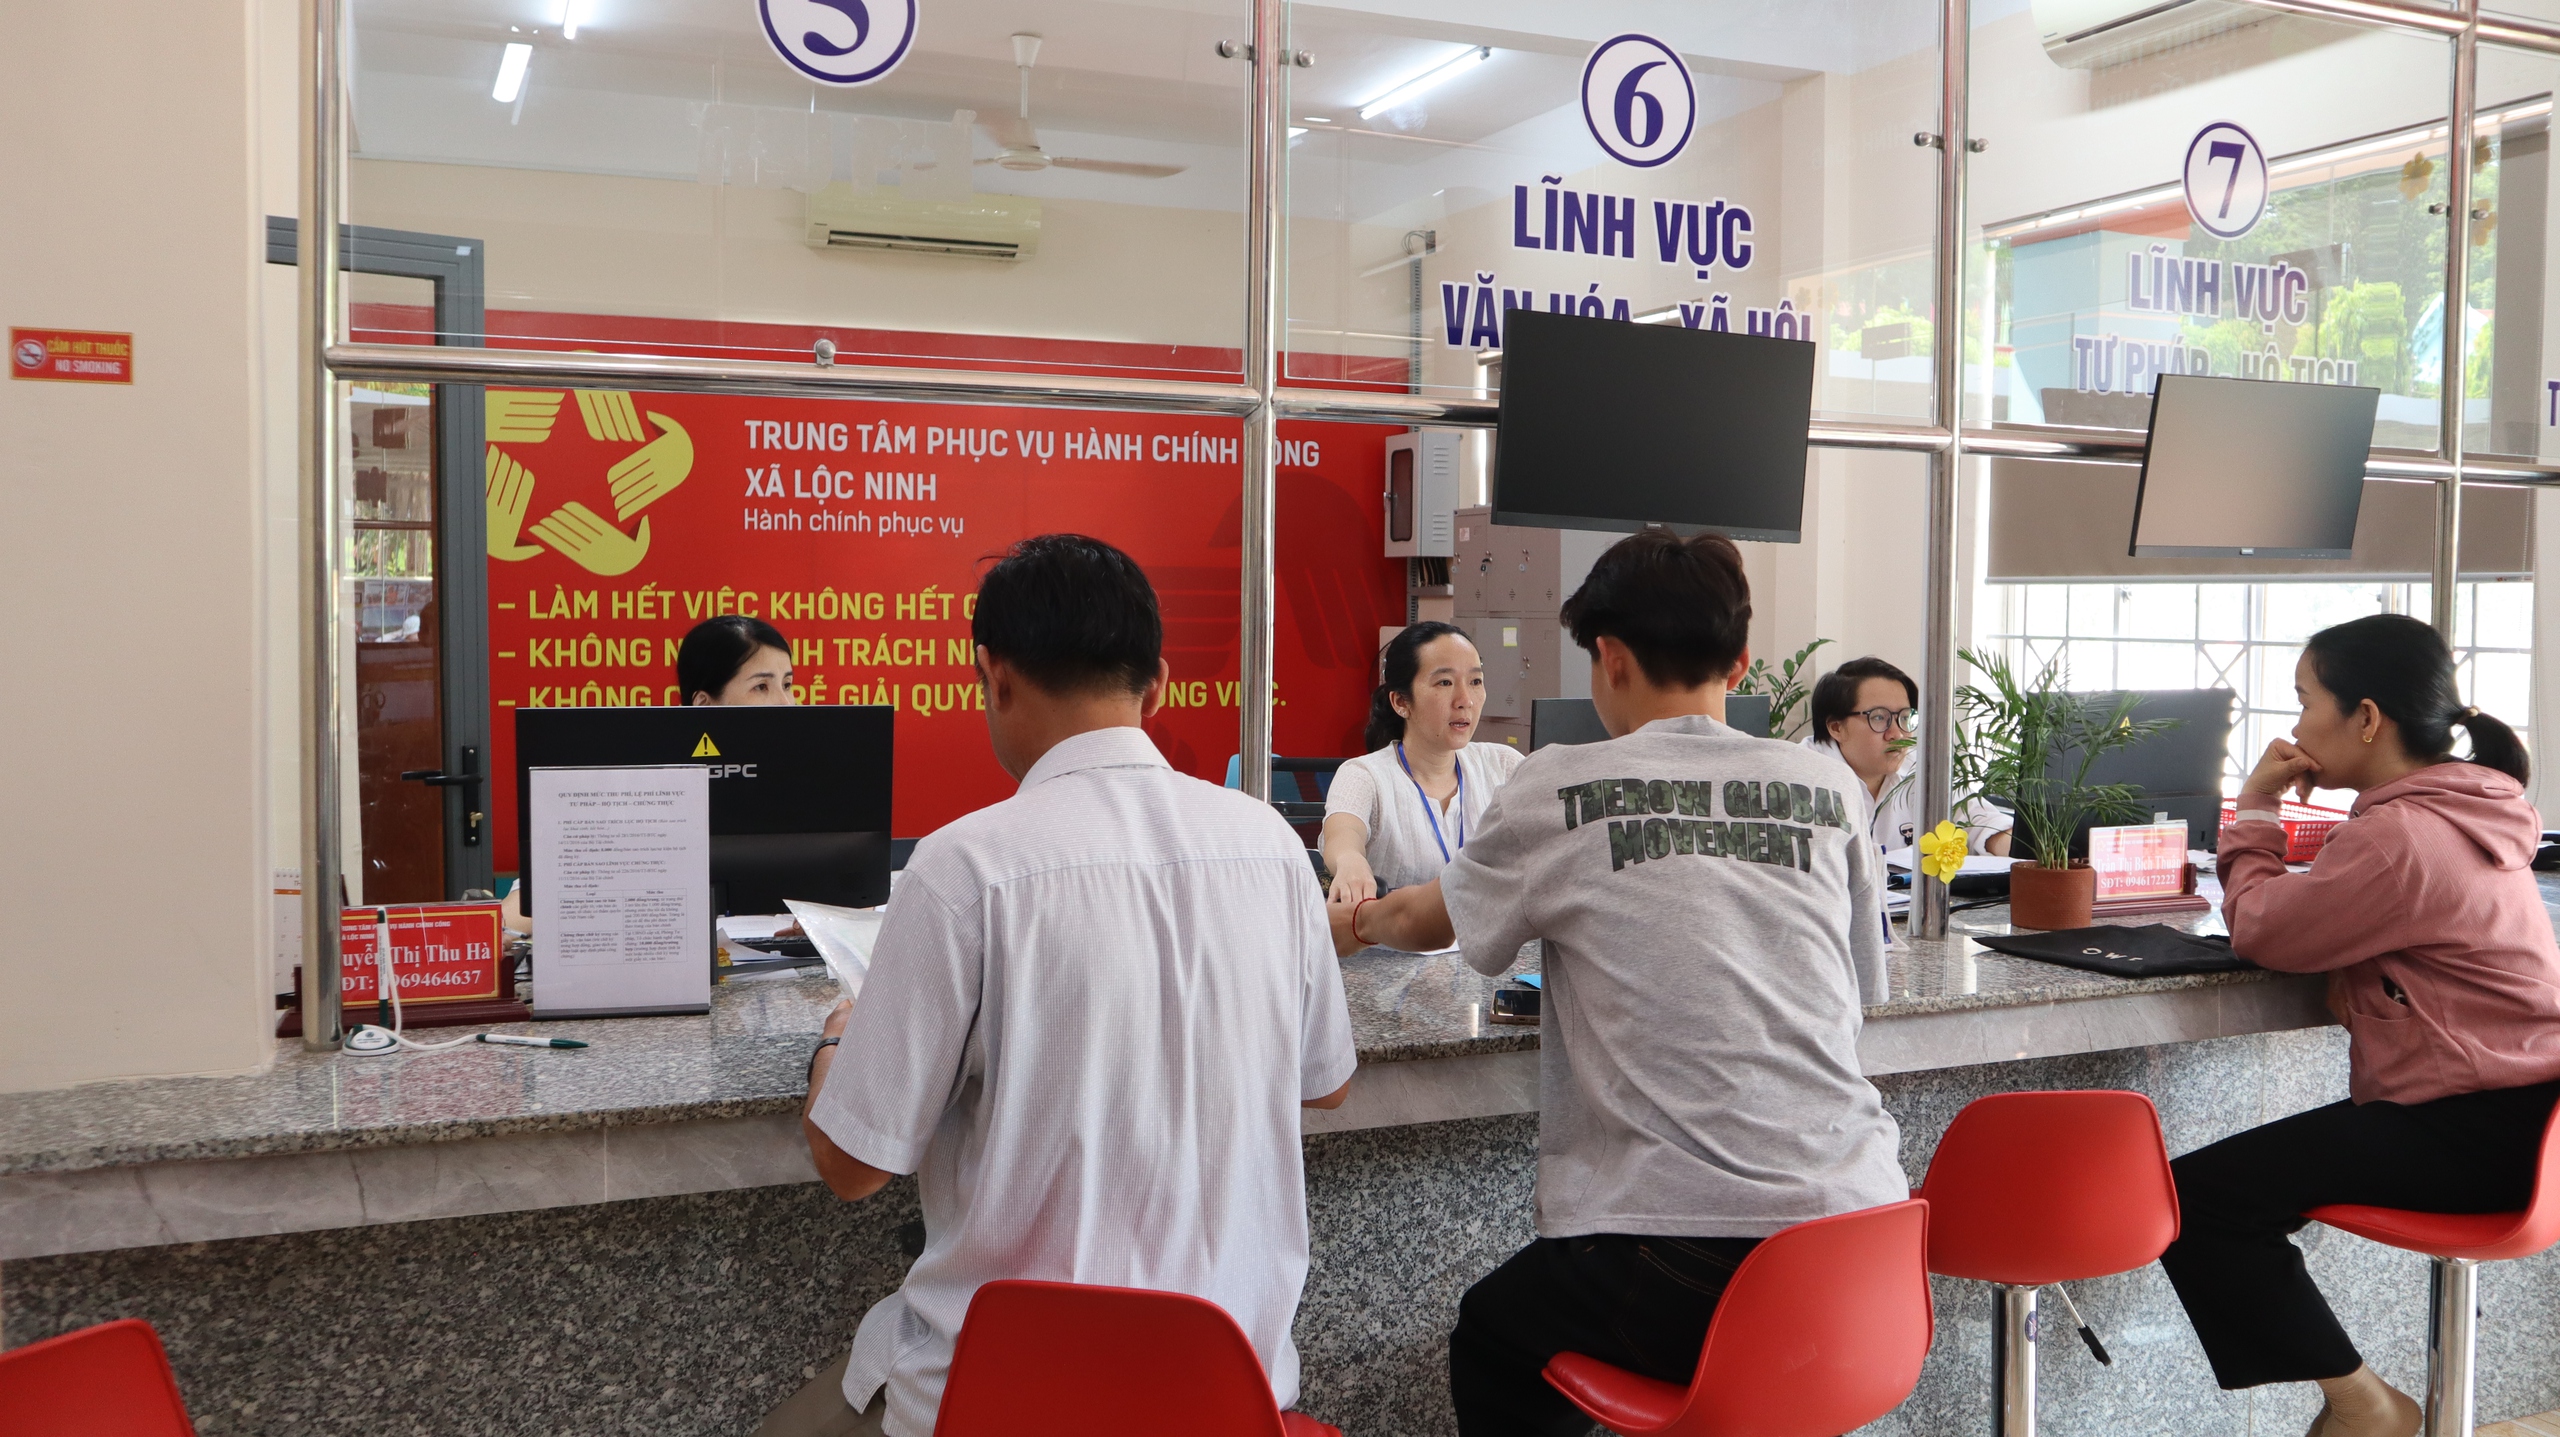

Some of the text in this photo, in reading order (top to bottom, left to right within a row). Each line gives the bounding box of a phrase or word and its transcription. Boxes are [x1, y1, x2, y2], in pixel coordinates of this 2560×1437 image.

[1614, 61, 1667, 148] 6
[2208, 141, 2246, 219] 7
[1514, 175, 1752, 280] LĨNH VỰC
[2130, 245, 2306, 334] LĨNH VỰC
[55, 359, 122, 374] NO SMOKING
[2075, 336, 2118, 393] TƯ
[744, 420, 848, 452] TRUNG
[856, 419, 916, 454] TÂM
[927, 426, 1008, 463] PHỤC
[1016, 429, 1055, 465] VỤ
[1065, 426, 1142, 461] HÀNH
[1152, 430, 1237, 464] CHÍNH
[745, 463, 937, 506] XÃ LỘC NINH
[744, 508, 964, 538] Hành chính phục vụ
[529, 584, 598, 619] LÀM
[611, 581, 676, 619] HẾT
[770, 586, 884, 620] KHÔNG
[896, 584, 955, 620] HẾT
[529, 632, 652, 667] KHÔNG
[832, 632, 936, 666] TRÁCH
[1557, 778, 1852, 835] THEROW GLOBAL
[1608, 818, 1813, 873] MOVEMENT
[2101, 874, 2176, 889] SĐT: 0946172222
[391, 945, 420, 968] Thị
[425, 944, 460, 963] Thu
[466, 942, 491, 961] Hà
